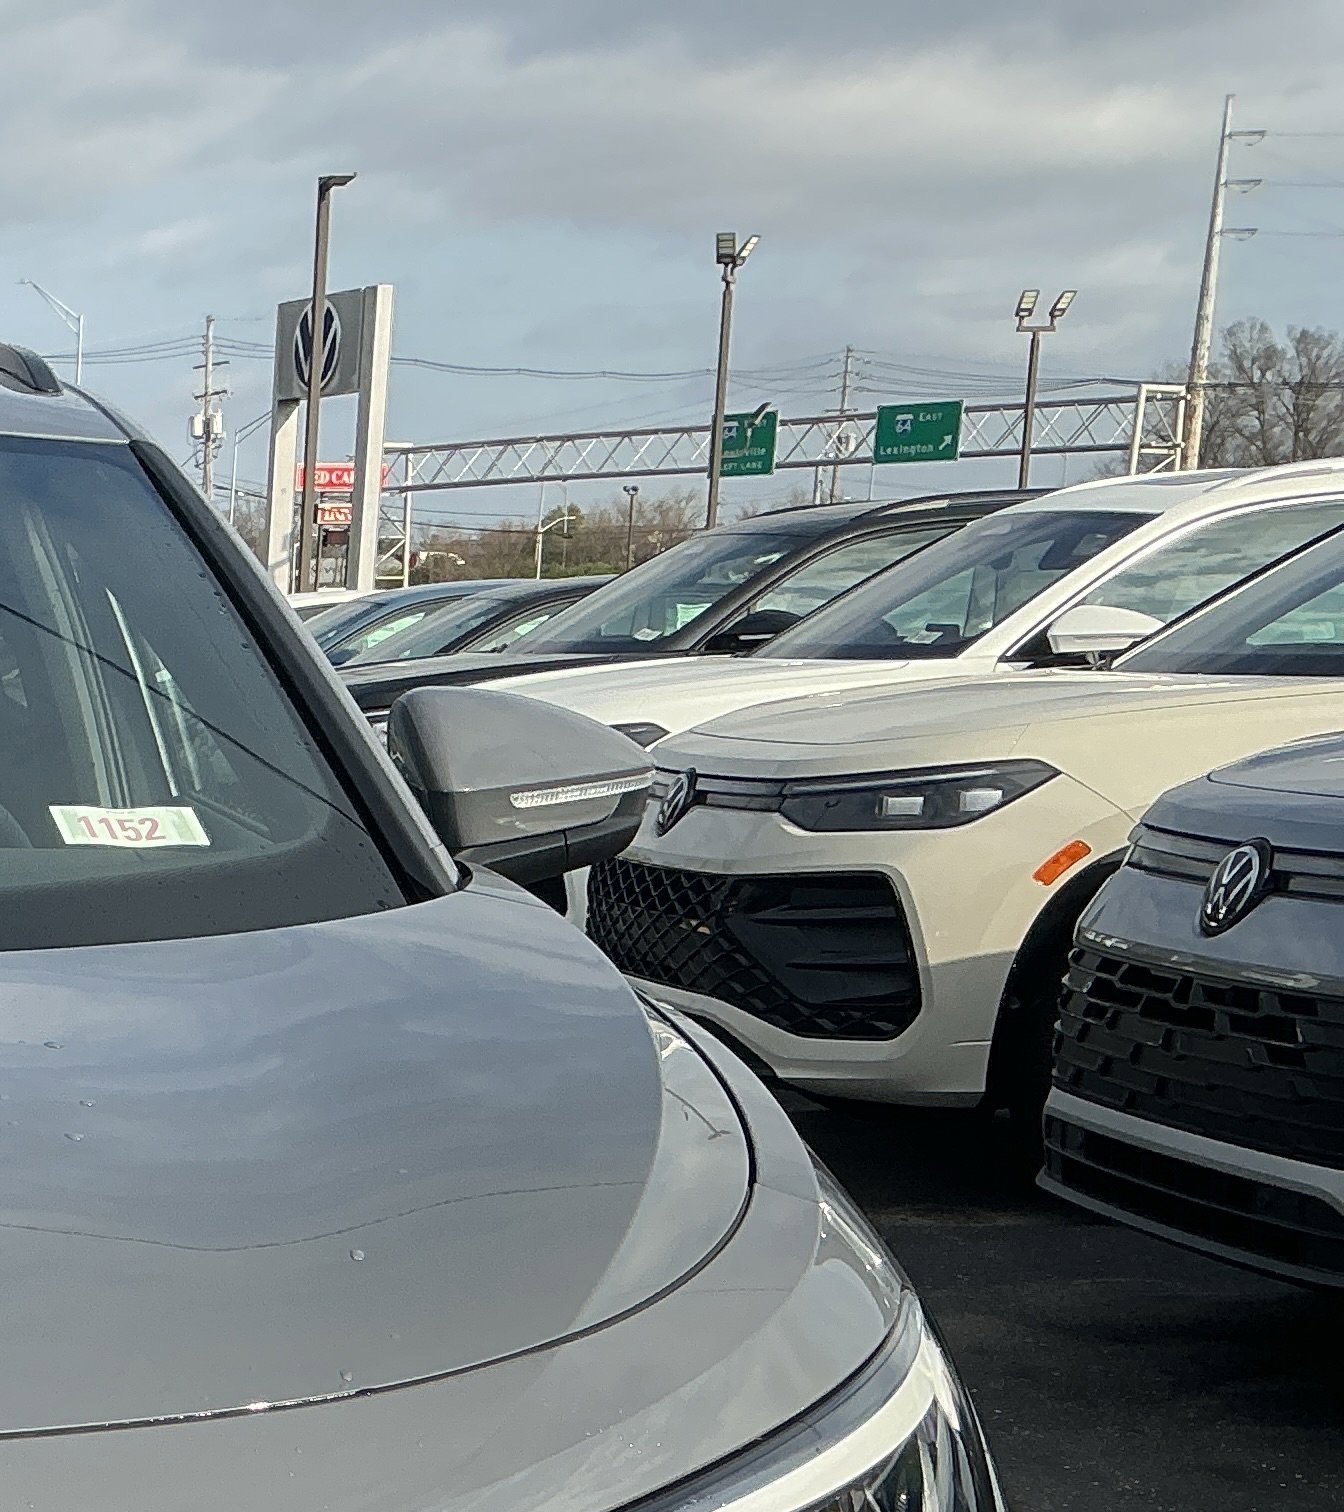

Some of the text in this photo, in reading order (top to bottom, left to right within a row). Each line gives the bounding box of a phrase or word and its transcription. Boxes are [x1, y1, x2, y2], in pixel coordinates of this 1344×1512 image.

[895, 419, 912, 433] 64
[879, 444, 934, 456] Lexington
[77, 815, 167, 842] 1152
